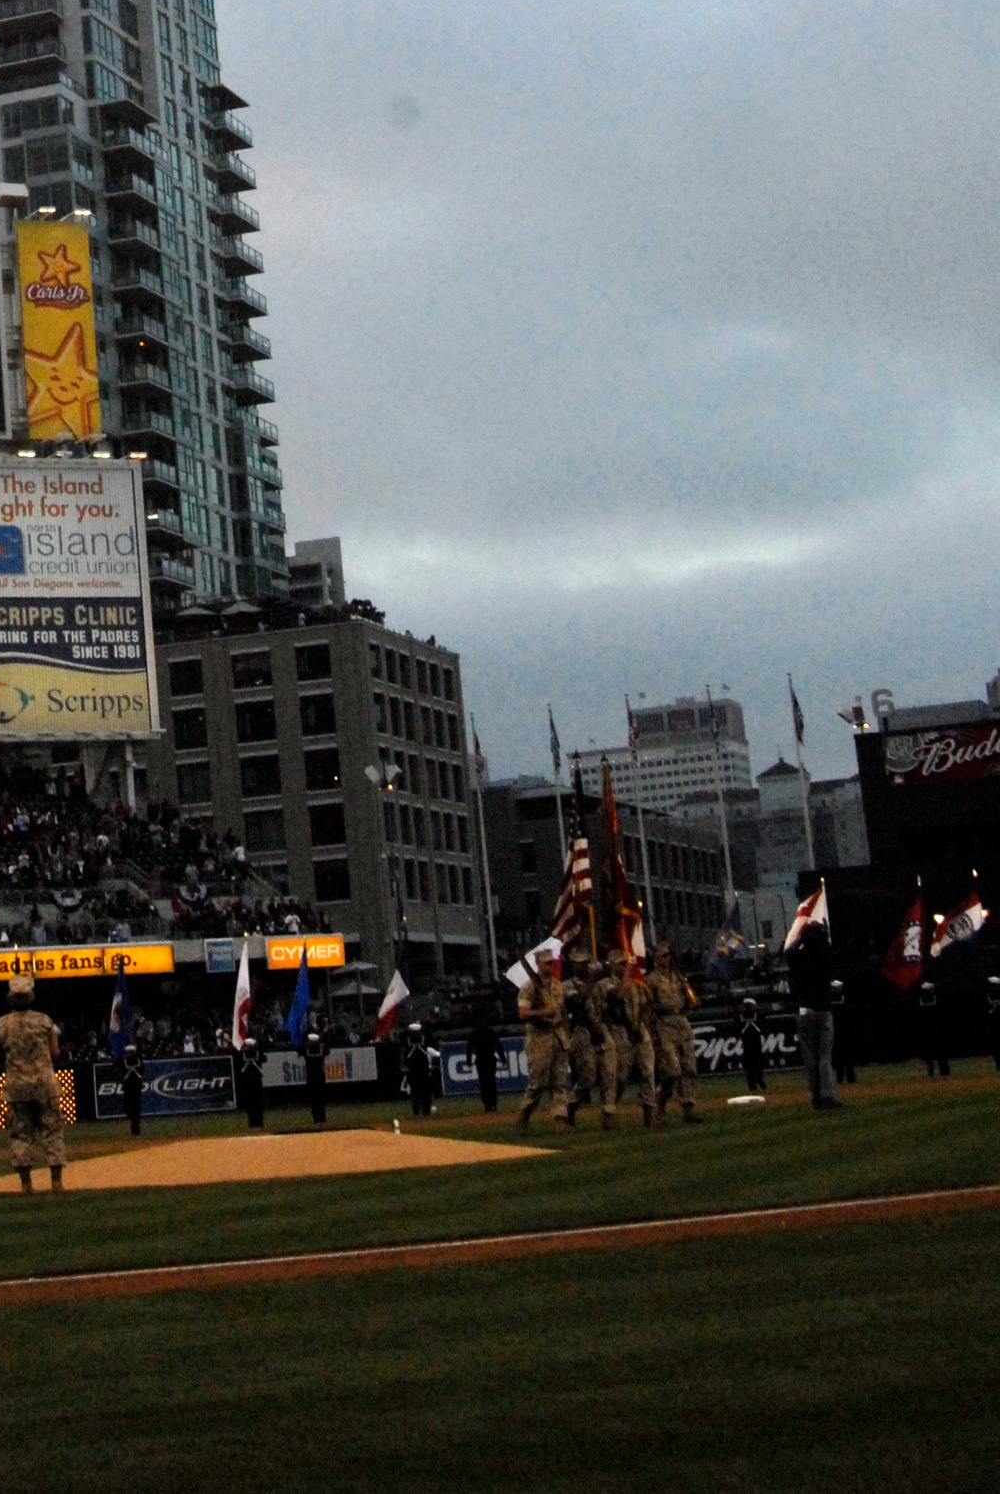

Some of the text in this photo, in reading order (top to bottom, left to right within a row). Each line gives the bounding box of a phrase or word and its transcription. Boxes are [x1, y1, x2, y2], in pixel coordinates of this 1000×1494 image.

[0, 474, 104, 495] The Island
[40, 496, 69, 517] for
[75, 502, 120, 523] you.
[27, 525, 136, 556] island
[28, 558, 138, 575] credit union
[11, 578, 30, 589] San
[33, 578, 74, 591] Diegans
[74, 604, 138, 626] CLINIC
[33, 630, 57, 644] FOR
[62, 630, 86, 643] THE
[91, 629, 139, 644] PADRES
[72, 644, 140, 659] SINCE 1981
[47, 688, 143, 718] Scripps
[271, 944, 340, 961] CYMER
[60, 953, 103, 970] fans
[163, 1076, 230, 1091] LIGHT
